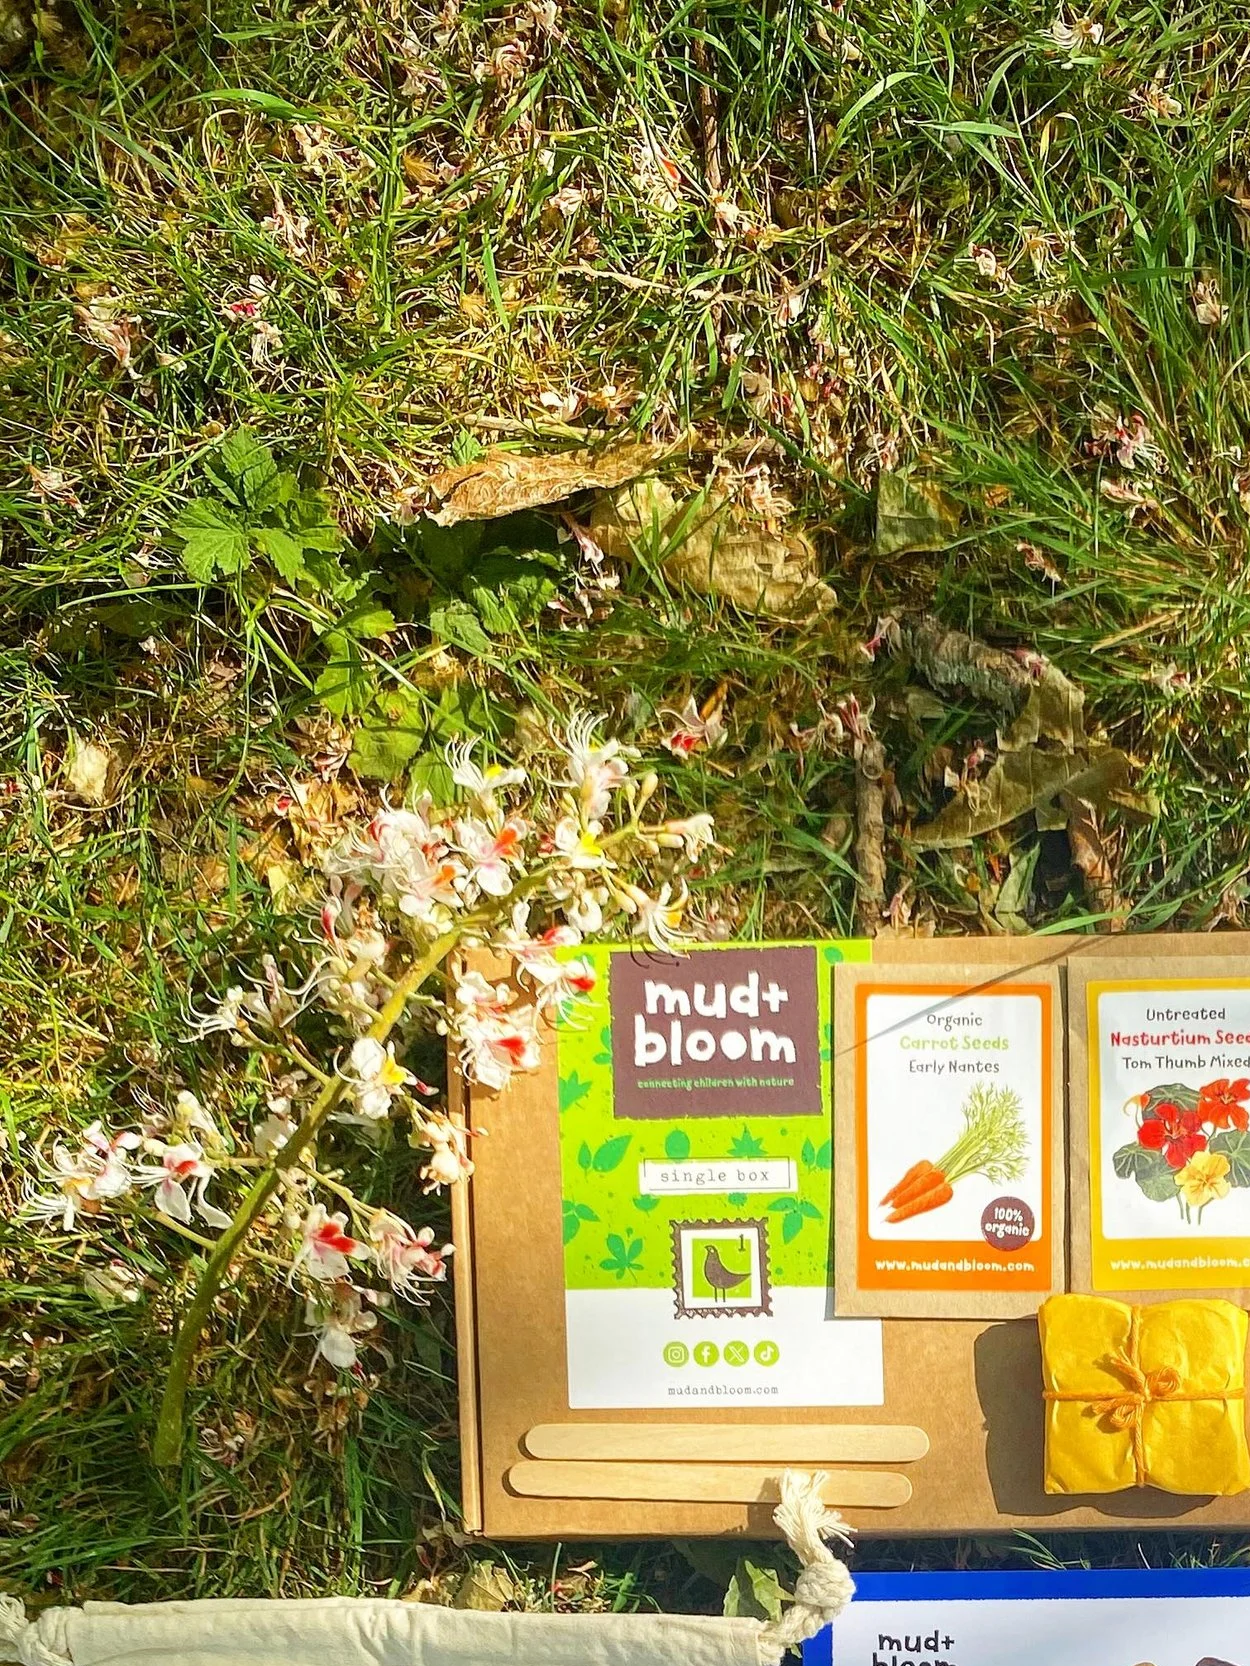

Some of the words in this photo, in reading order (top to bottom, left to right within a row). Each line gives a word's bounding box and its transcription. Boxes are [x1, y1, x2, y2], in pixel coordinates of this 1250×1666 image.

[643, 971, 789, 1018] mud+
[925, 1009, 983, 1032] Organic
[1145, 1007, 1226, 1021] Untreated
[633, 1013, 796, 1066] bloom
[899, 1035, 959, 1050] Carrot
[961, 1035, 1009, 1050] Seeds
[1110, 1029, 1211, 1046] Nasturtium
[908, 1059, 945, 1075] Early
[948, 1059, 1000, 1073] Nantes
[1121, 1056, 1152, 1069] Tom
[1154, 1054, 1206, 1069] Thumb
[1209, 1053, 1250, 1068] Mixed
[637, 1077, 692, 1091] connecting
[693, 1077, 734, 1088] children
[735, 1076, 758, 1087] with
[759, 1077, 794, 1087] nature
[660, 1168, 727, 1185] single
[735, 1168, 769, 1182] box
[993, 1206, 1023, 1222] 100%
[983, 1219, 1032, 1241] organic
[738, 1234, 746, 1252] 1
[874, 1258, 1035, 1271] www.mudandbloom.com
[667, 1384, 779, 1395] mudandbloom.com
[877, 1629, 955, 1653] mud+
